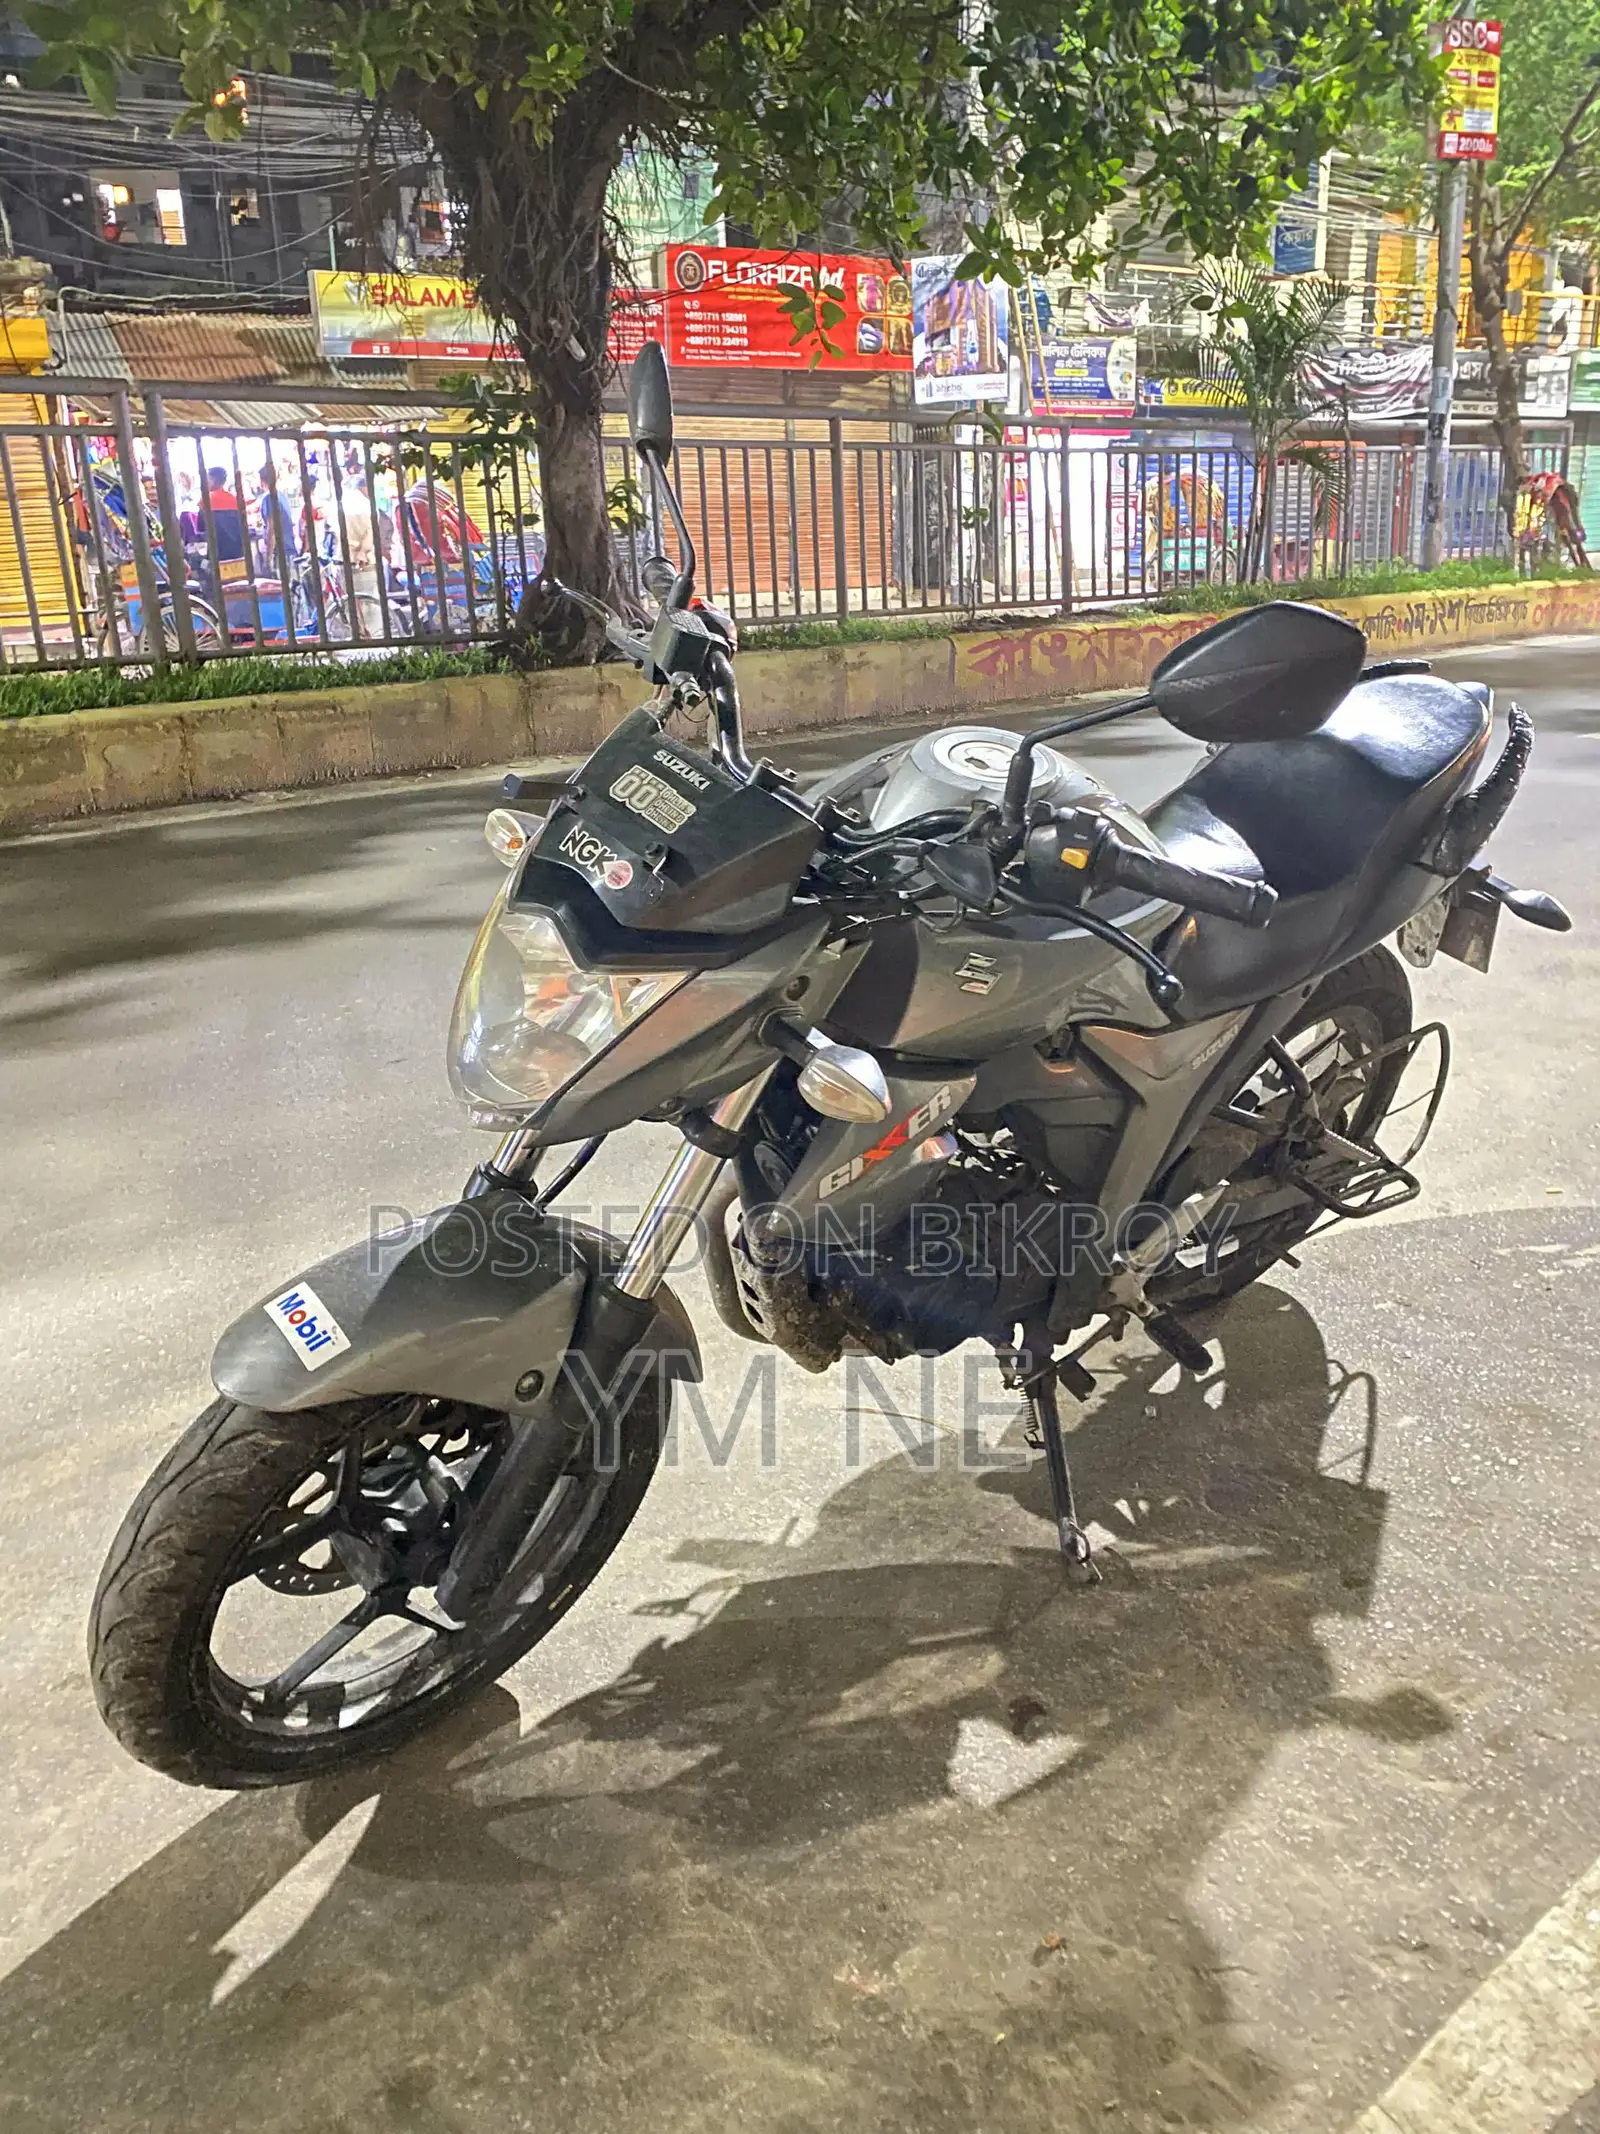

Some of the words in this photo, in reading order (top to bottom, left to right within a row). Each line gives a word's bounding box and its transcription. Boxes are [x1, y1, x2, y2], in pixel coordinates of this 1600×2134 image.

[1446, 20, 1487, 49] SSC
[371, 284, 457, 308] SALAM
[652, 749, 712, 791] SUZUKI
[559, 826, 618, 878] NGK
[276, 1292, 332, 1352] Mobil
